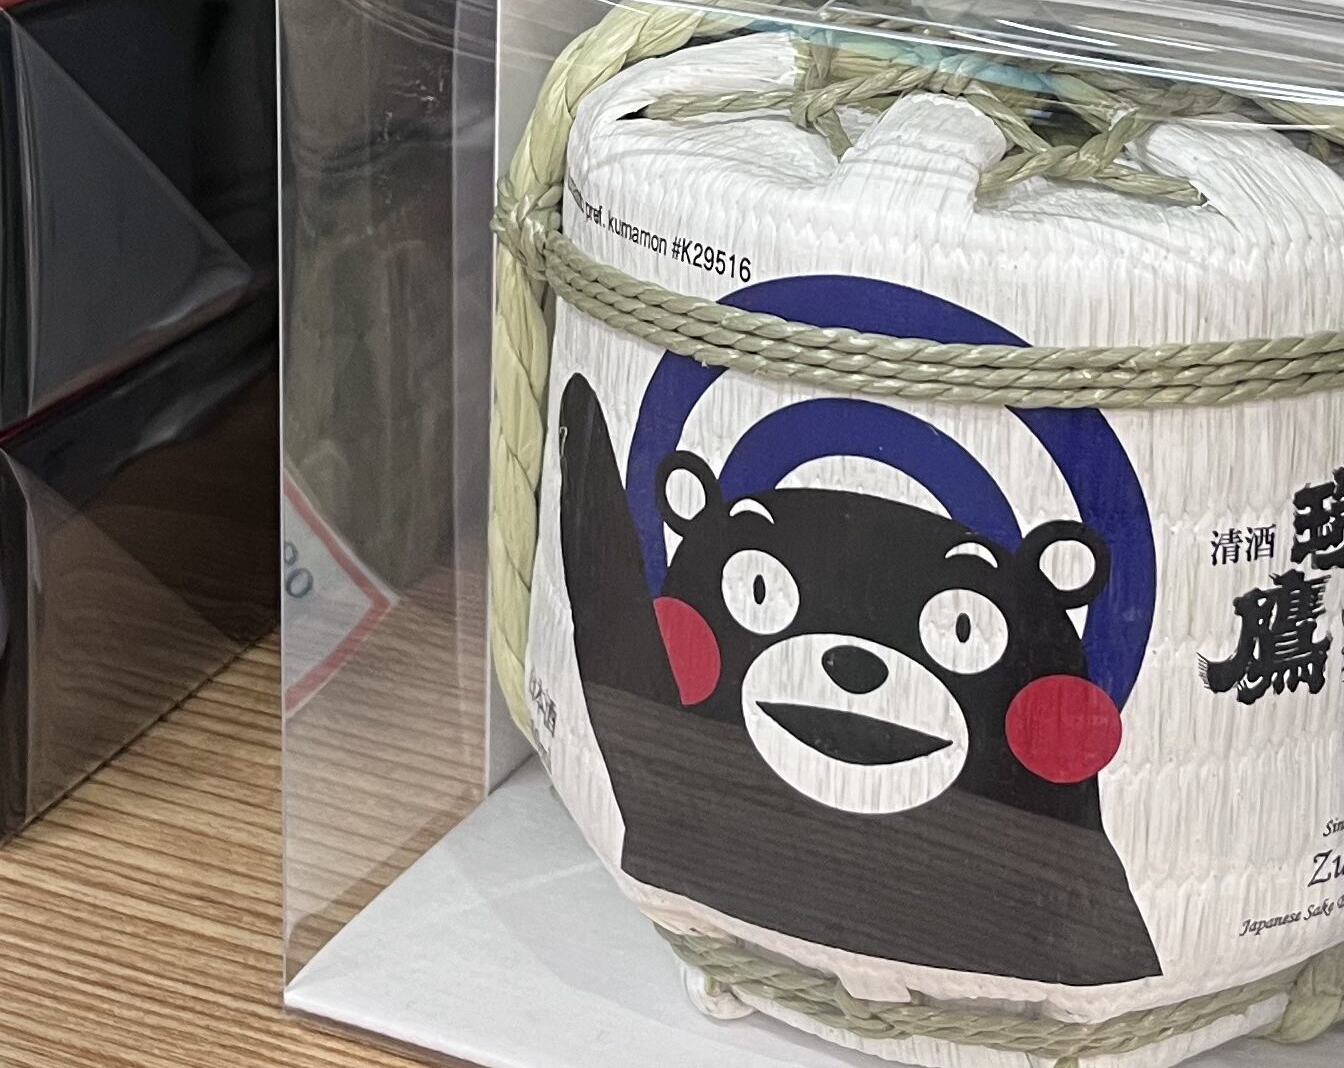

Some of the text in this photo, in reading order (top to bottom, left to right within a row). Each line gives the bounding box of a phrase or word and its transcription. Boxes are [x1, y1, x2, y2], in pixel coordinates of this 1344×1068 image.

[585, 201, 752, 283] pref. kumamon #K29516
[1211, 523, 1277, 566] 清酒
[1239, 910, 1302, 937] Japanese
[1304, 898, 1334, 921] Sake
